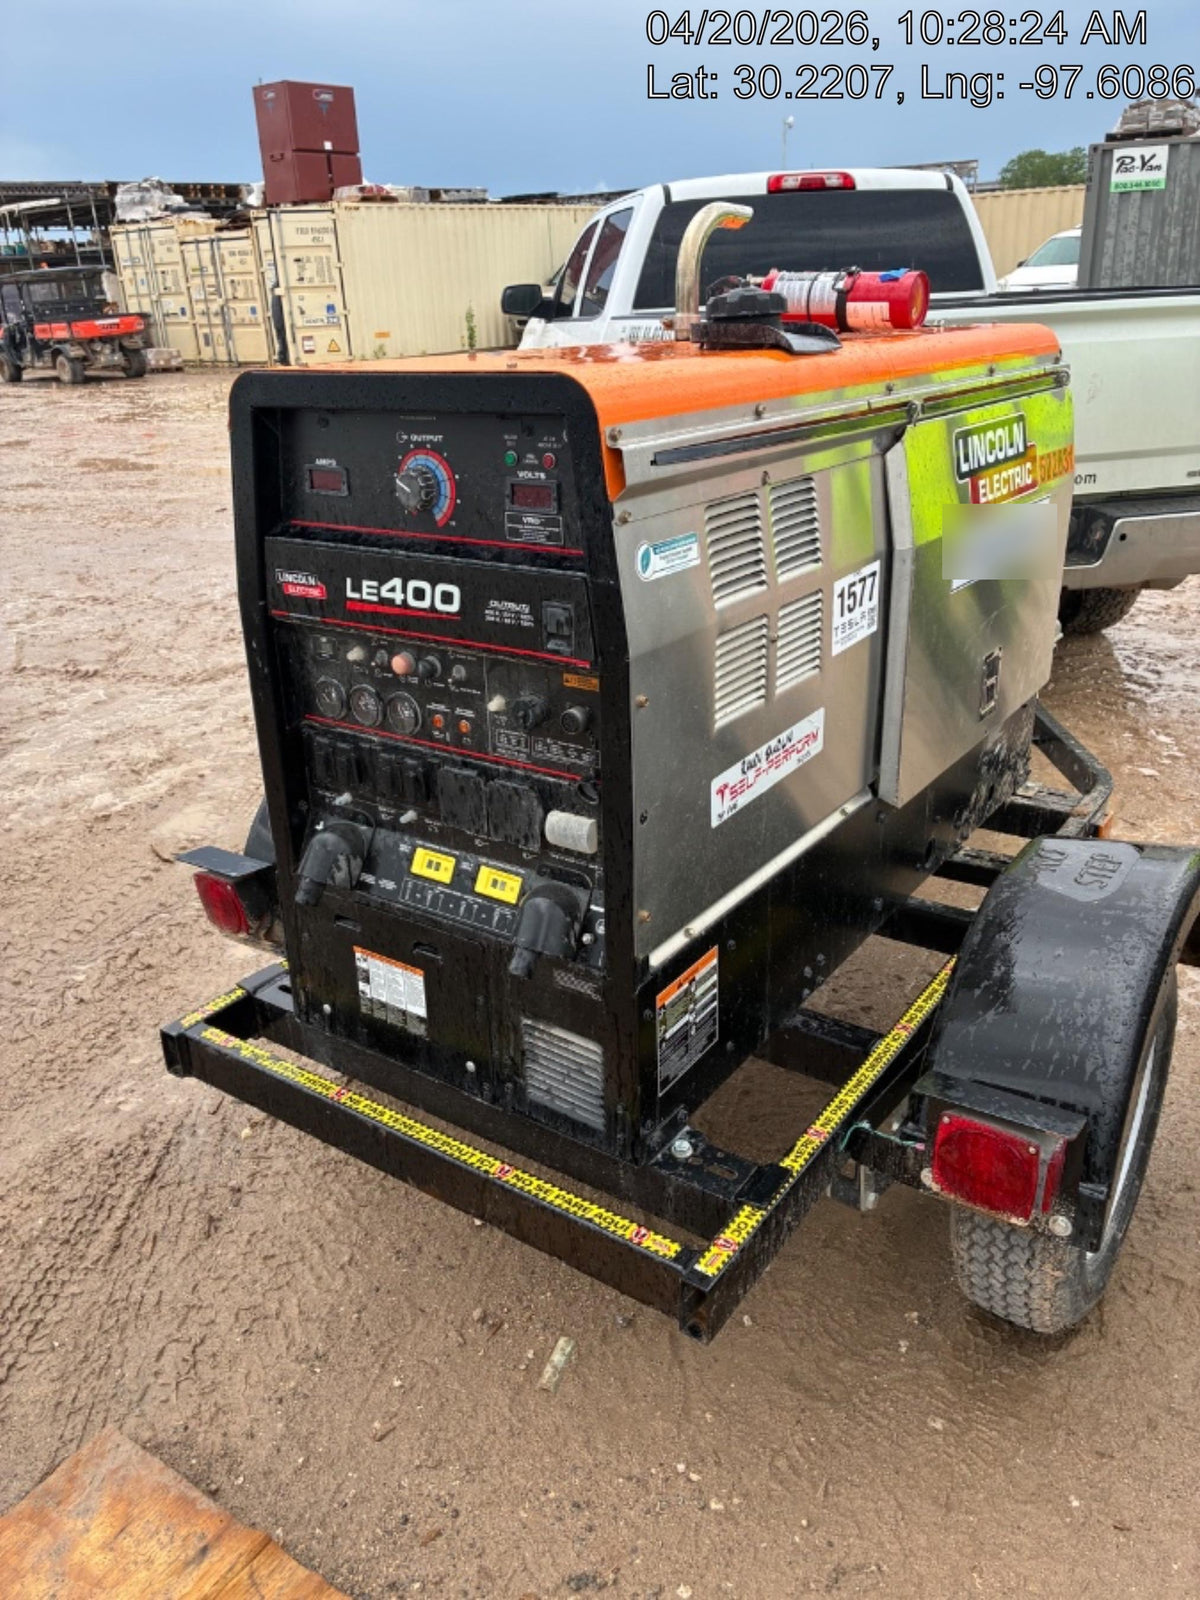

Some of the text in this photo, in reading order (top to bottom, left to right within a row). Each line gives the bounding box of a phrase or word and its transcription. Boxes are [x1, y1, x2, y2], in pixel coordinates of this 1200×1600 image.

[1116, 153, 1162, 174] Pac-Van
[958, 421, 1025, 473] LINCOLN
[517, 471, 547, 480] VOLTS
[978, 461, 1034, 503] ELECTRIC
[277, 571, 316, 586] LINCOLN
[288, 585, 323, 597] ELECTRIC
[837, 570, 877, 617] 1577
[346, 577, 461, 613] LE400
[1073, 853, 1122, 890] STEP
[425, 1131, 477, 1159] DEBOUT
[512, 1174, 532, 1187] NO
[535, 1184, 555, 1197] SE
[555, 1194, 594, 1213] PARE
[731, 1221, 748, 1238] DO
